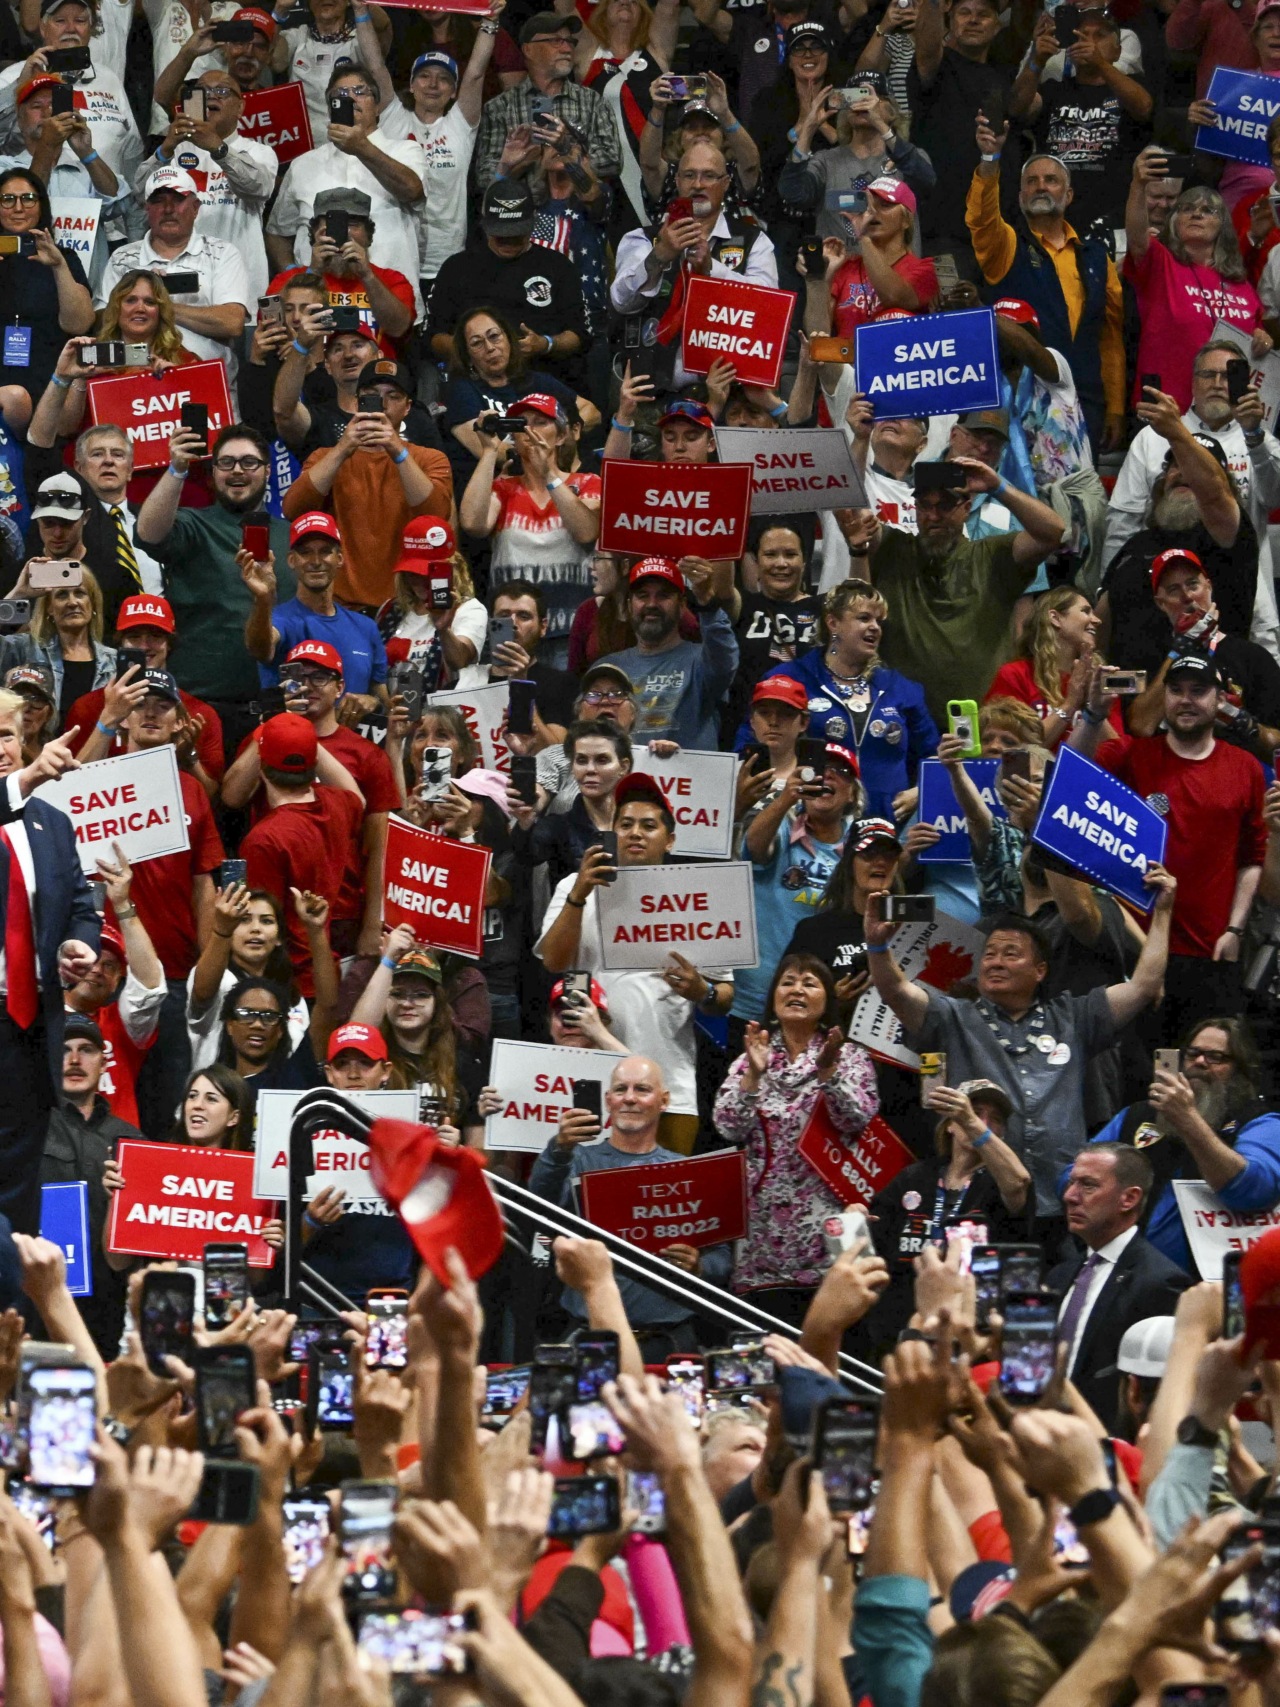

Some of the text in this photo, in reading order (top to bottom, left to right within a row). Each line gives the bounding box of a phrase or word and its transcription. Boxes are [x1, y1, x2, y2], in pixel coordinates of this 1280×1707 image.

[792, 22, 824, 34] TRUMP
[850, 71, 880, 83] TRUMP
[1238, 96, 1280, 118] SAV
[237, 111, 272, 131] AVE
[1213, 115, 1268, 139] AMER
[53, 216, 95, 233] ARAH
[56, 239, 91, 253] ASKA
[995, 301, 1021, 310] UMP
[1185, 284, 1248, 306] WOMEN
[1210, 299, 1229, 307] FOR
[707, 305, 755, 328] SAVE
[1192, 302, 1250, 320] TRUMP
[8, 336, 28, 344] RALLY
[689, 329, 773, 360] AMERICA!
[894, 339, 957, 363] SAVE
[868, 363, 986, 395] AMERICA!
[131, 390, 192, 417] SAVE
[754, 453, 816, 472] SAVE
[751, 474, 849, 494] MERICA!
[644, 489, 711, 510] SAVE
[614, 513, 735, 538] AMERICA!
[636, 564, 674, 579] AMERICA
[642, 557, 665, 567] SAVE
[145, 670, 169, 682] UMP
[647, 670, 684, 685] UTAH
[70, 783, 138, 814] SAVE
[1085, 790, 1139, 837] SAVE
[75, 805, 171, 846] MERICA!
[1052, 804, 1148, 875] AMERICA
[402, 857, 449, 889] SAVE
[387, 882, 471, 924] AMERICA!
[640, 892, 709, 913] SAVE
[613, 920, 742, 944] AMERICA!
[534, 1073, 576, 1095] SAV
[822, 1138, 875, 1203] TO 8802
[161, 1174, 235, 1201] SAVE
[638, 1180, 694, 1198] TEXT
[126, 1202, 263, 1236] AMERICA!
[632, 1199, 703, 1220] RALLY
[620, 1216, 721, 1242] TO 88022
